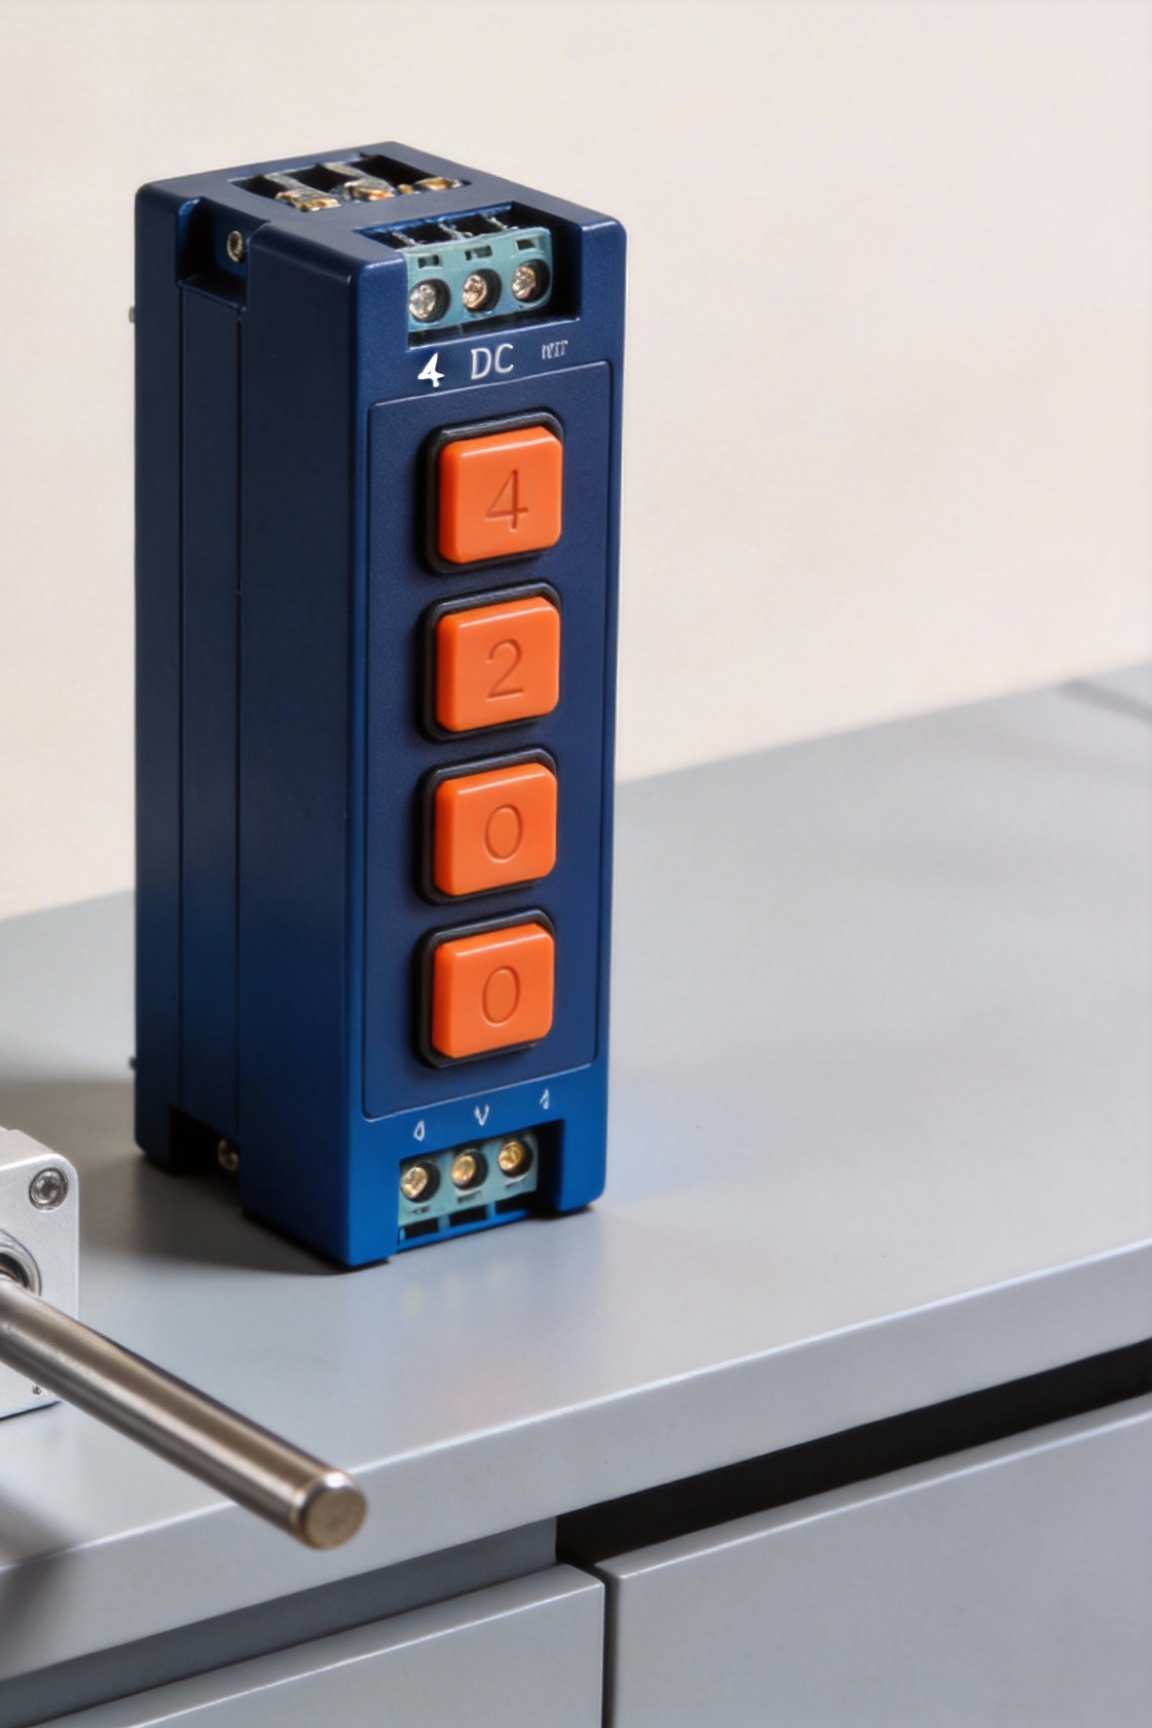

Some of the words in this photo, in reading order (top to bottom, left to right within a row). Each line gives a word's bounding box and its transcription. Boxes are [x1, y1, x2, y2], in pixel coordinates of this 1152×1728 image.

[470, 343, 514, 381] DC
[484, 468, 529, 532] 4
[485, 637, 525, 702] 2
[484, 803, 524, 864] 0
[481, 964, 521, 1028] 0
